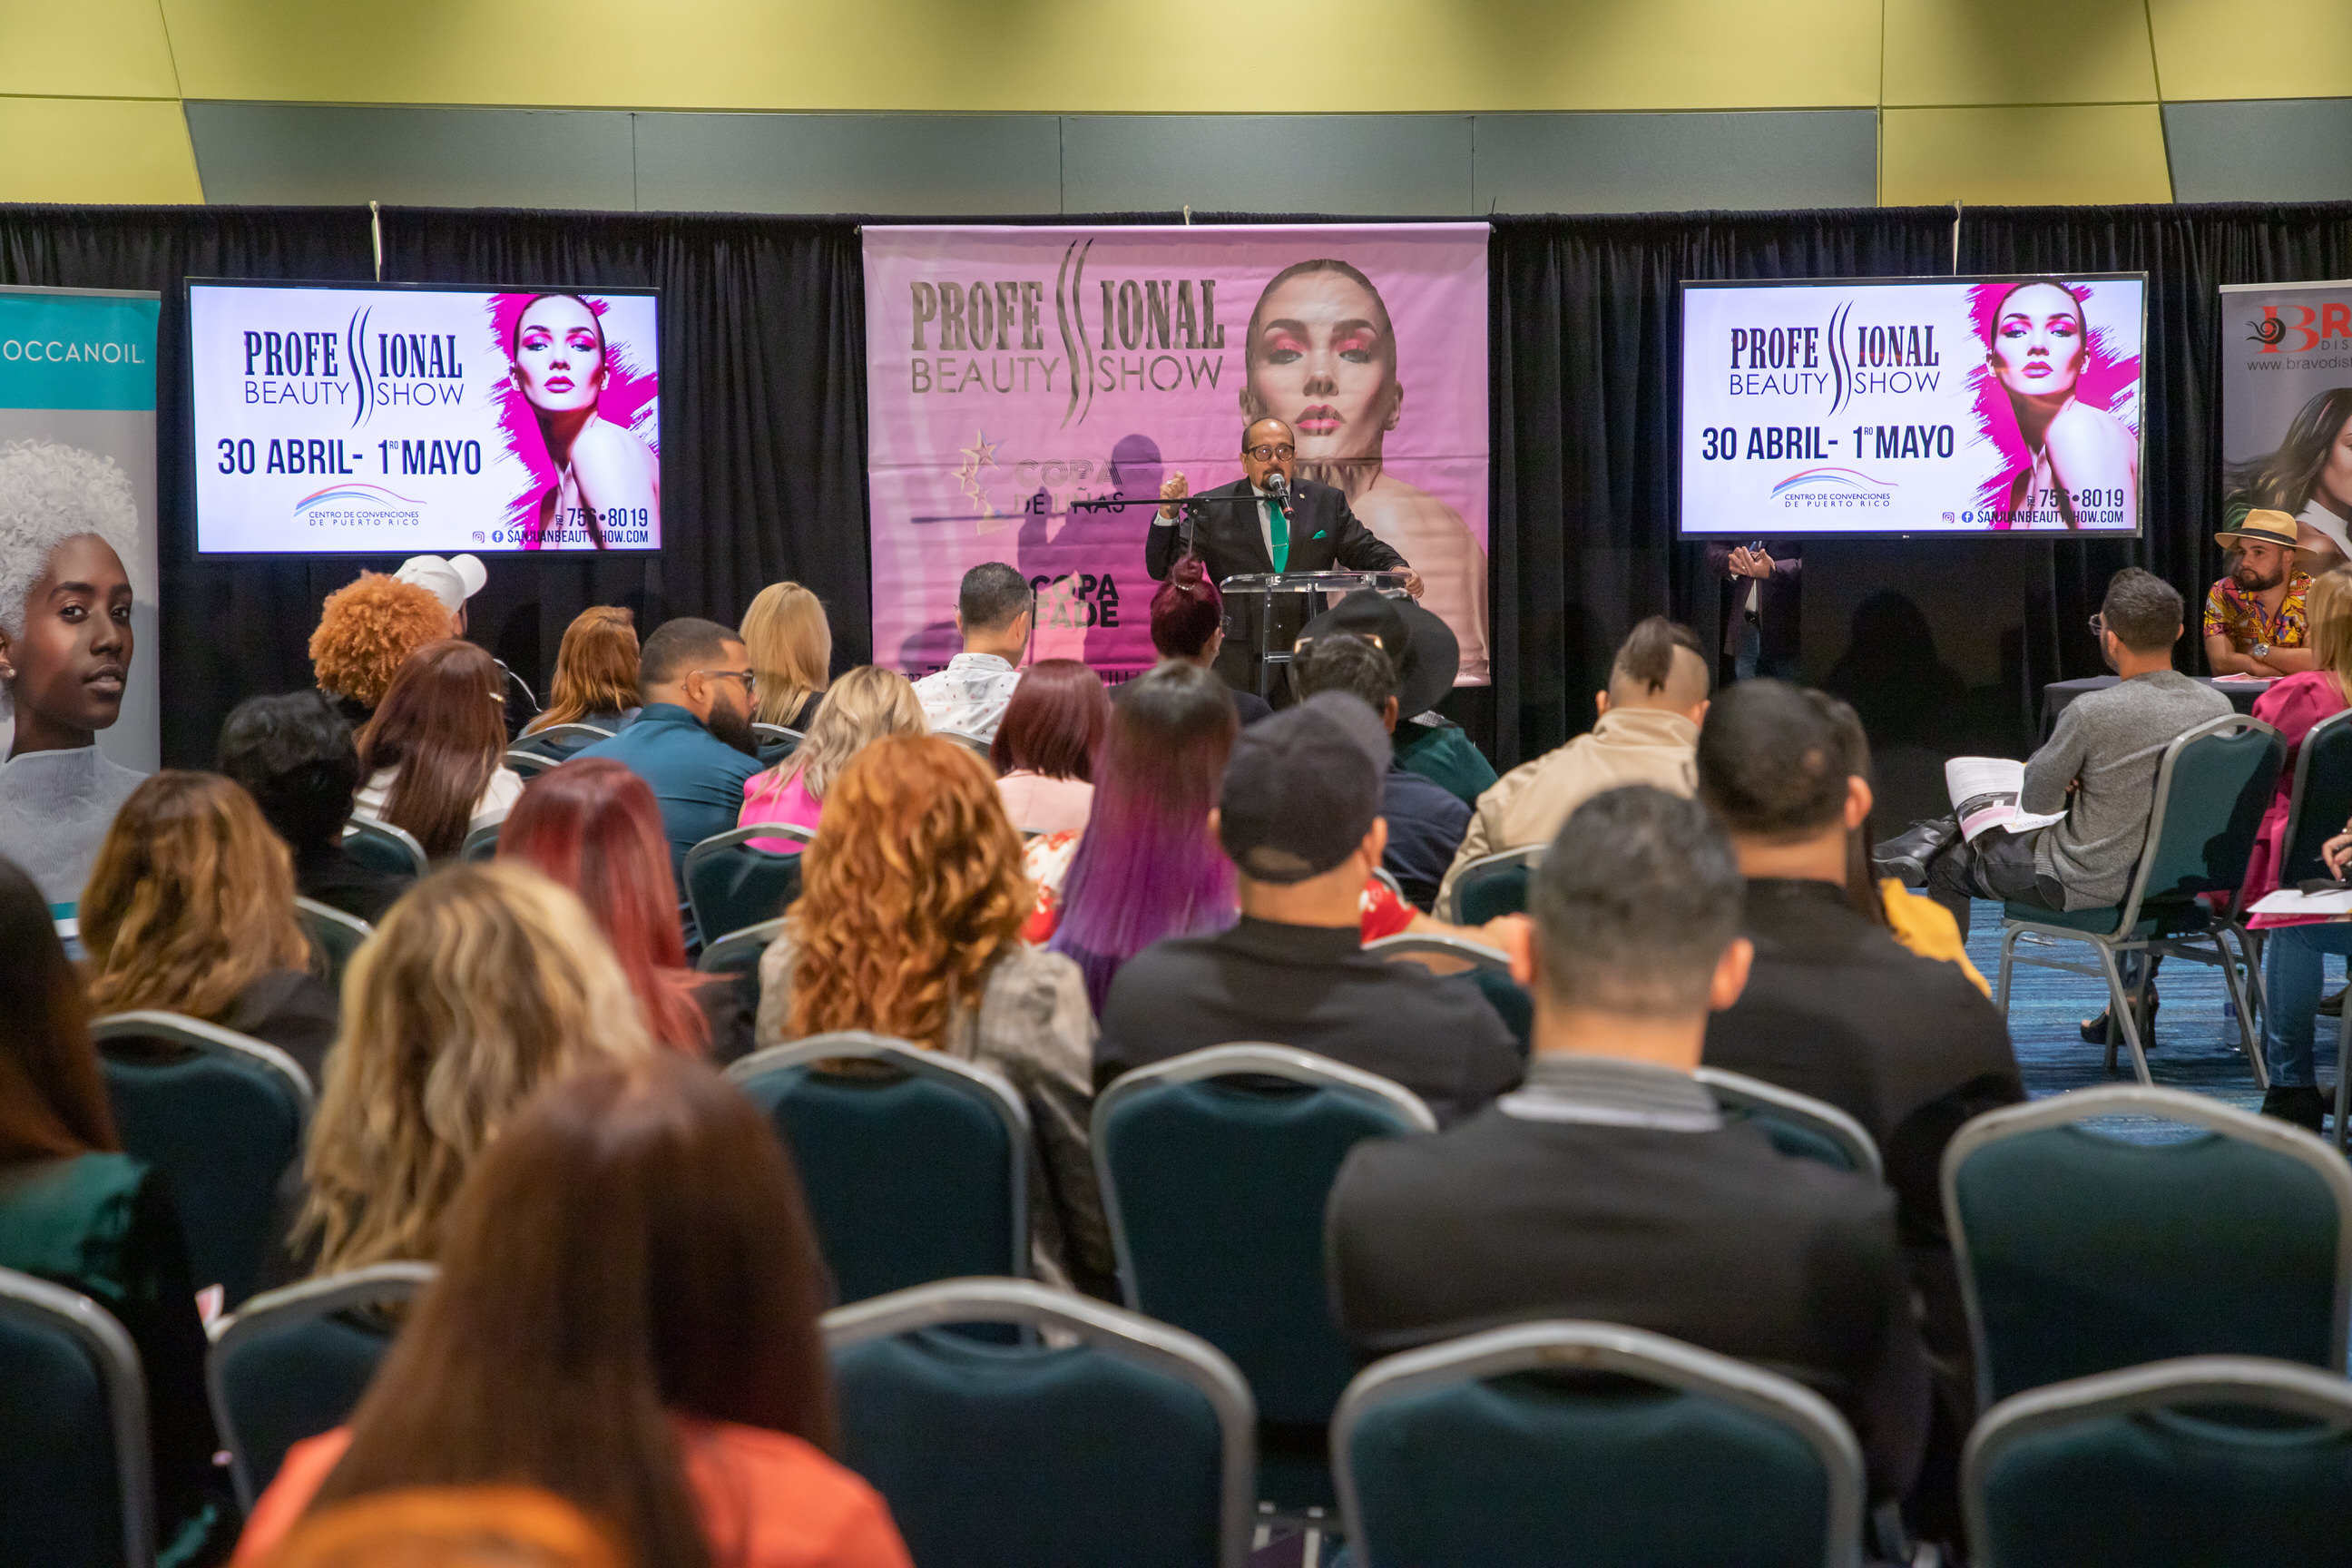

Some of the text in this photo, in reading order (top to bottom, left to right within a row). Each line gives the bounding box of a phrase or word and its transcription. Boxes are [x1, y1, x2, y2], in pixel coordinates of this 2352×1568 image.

[3, 339, 142, 364] OCCANOIL
[2321, 340, 2349, 350] DIS
[911, 355, 1223, 393] BEAUTY SHOW
[1730, 371, 1940, 395] BEAUTY SHOW
[245, 381, 465, 406] BEAUTY SHOW
[1702, 426, 1737, 460] 30
[1876, 425, 1955, 458] MAYO
[218, 438, 255, 475] 30
[402, 439, 481, 475] MAYO
[1015, 459, 1122, 487] COPA
[1014, 487, 1125, 514] DE UÑAS
[1977, 510, 2123, 524] SANJUANBEAUTHOW.COM
[507, 529, 648, 544] SANJUANBEAUTHOW.COM
[1030, 573, 1119, 603] COPA
[1032, 600, 1119, 630] FADE
